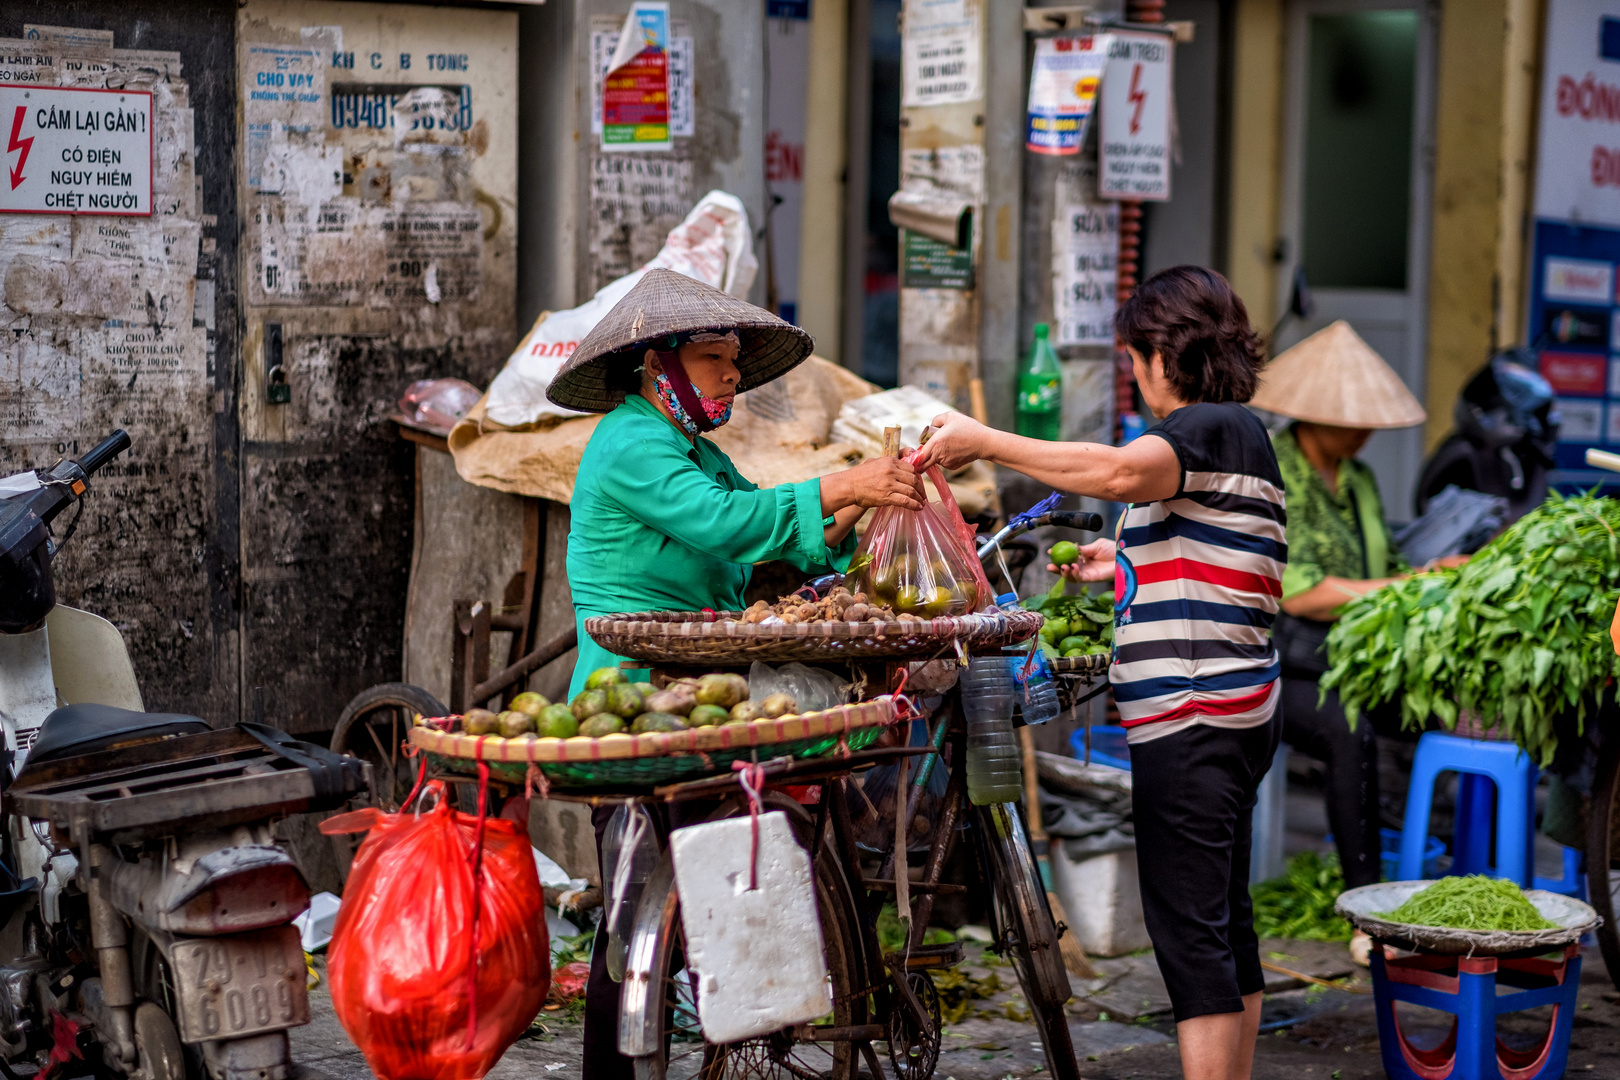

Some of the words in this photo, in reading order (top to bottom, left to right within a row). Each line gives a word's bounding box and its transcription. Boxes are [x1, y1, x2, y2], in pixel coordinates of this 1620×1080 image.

[13, 69, 41, 82] NGÀY
[256, 71, 285, 87] CHO
[288, 73, 314, 88] VAY
[36, 104, 71, 130] CẤM
[76, 110, 99, 136] LẠI
[104, 107, 136, 133] GẦN
[61, 145, 83, 163] CÓ
[87, 147, 121, 167] ĐIỆN
[51, 171, 93, 186] NGUY
[45, 190, 84, 208] CHẾT
[89, 191, 138, 209] NGƯỜI
[105, 343, 139, 354] KHÔNG
[147, 357, 160, 366] 100
[200, 978, 294, 1036] 6089
